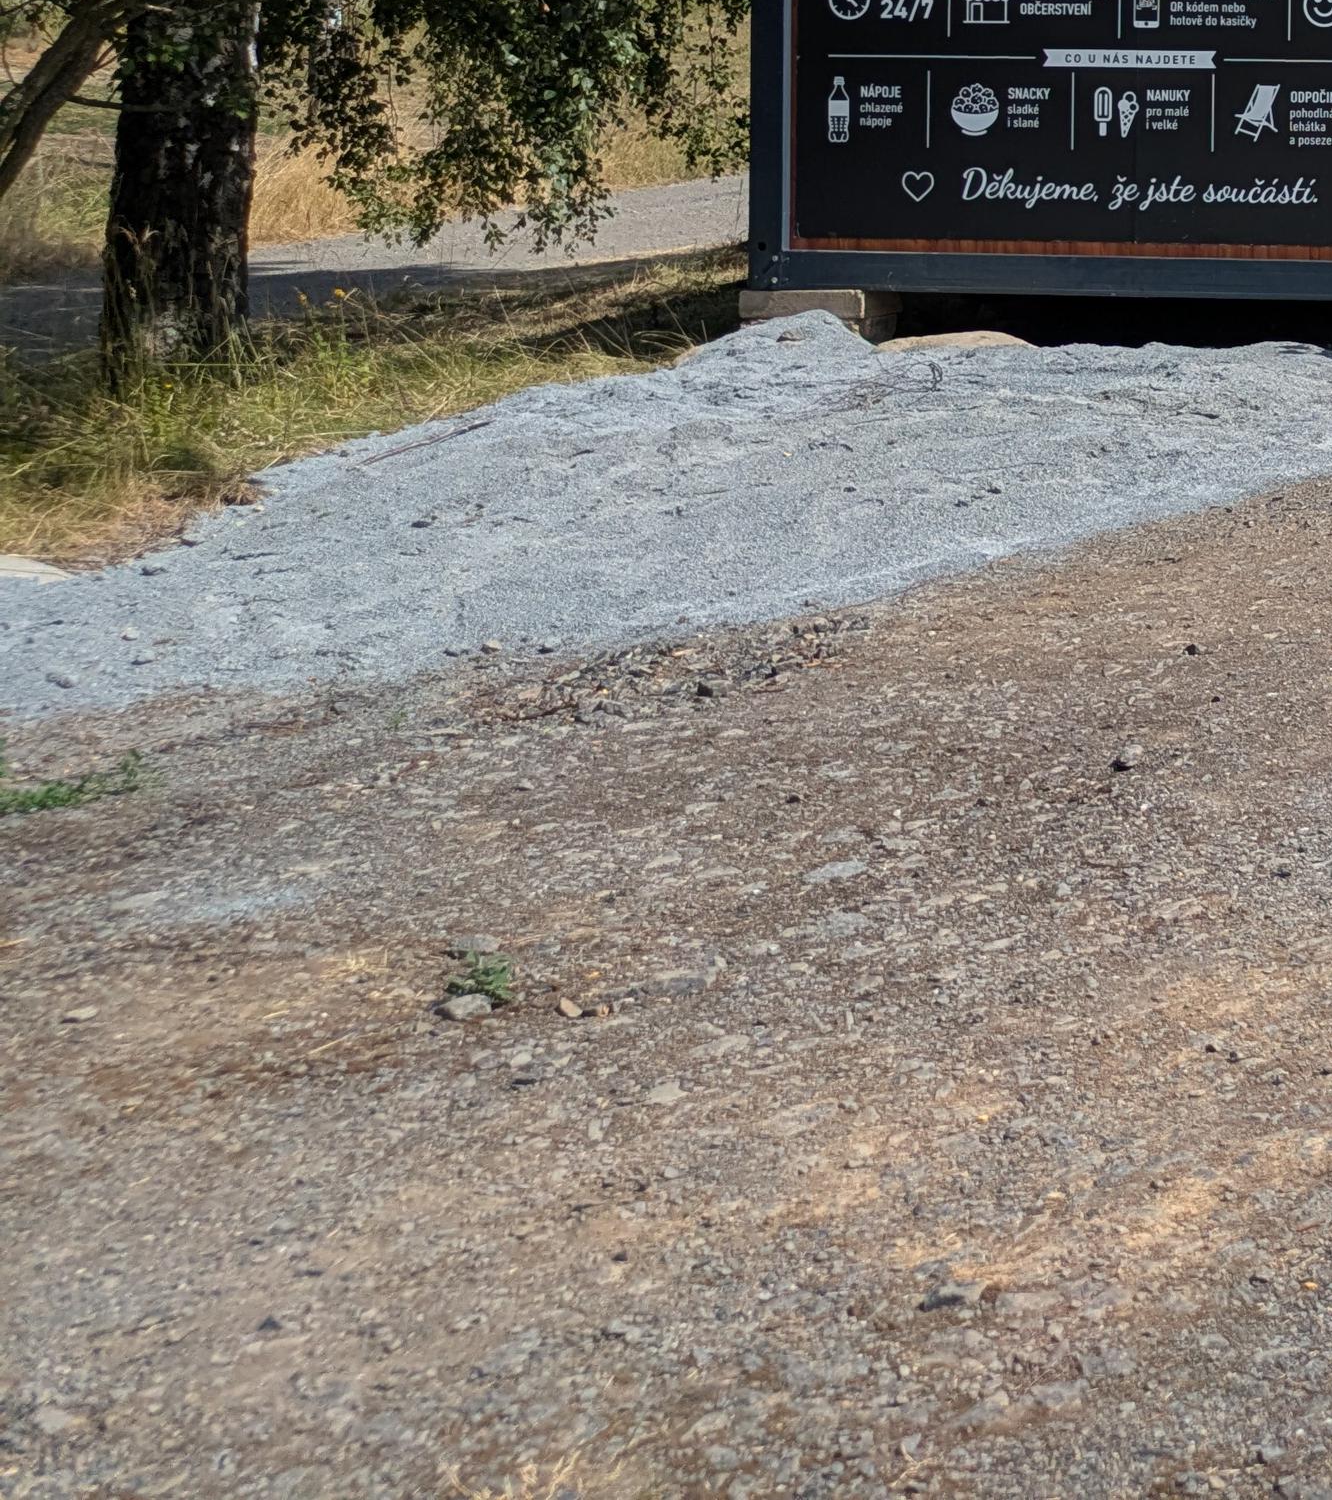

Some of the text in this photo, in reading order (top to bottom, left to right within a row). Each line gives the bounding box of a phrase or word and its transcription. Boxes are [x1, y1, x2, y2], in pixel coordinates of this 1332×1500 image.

[1020, 1, 1091, 15] OBČERSTVENÍ
[1170, 1, 1245, 12] QR kódem nebo
[1170, 15, 1256, 28] hotově do kasičky
[1065, 51, 1196, 64] CO U NÁS NAJDETE
[860, 84, 902, 99] NÁPOJE
[1008, 87, 1050, 99] SNACKY
[1147, 90, 1190, 101] NANUKY
[860, 102, 903, 113] chlazené
[1008, 104, 1039, 114] sladké
[1146, 106, 1189, 120] pro malé
[860, 115, 892, 128] nápoje
[1007, 116, 1039, 128] i slané
[1145, 118, 1178, 130] i velké
[1290, 121, 1326, 131] lehátka
[1289, 137, 1295, 145] a
[962, 167, 1317, 211] Děkujeme, že jste součástí.
